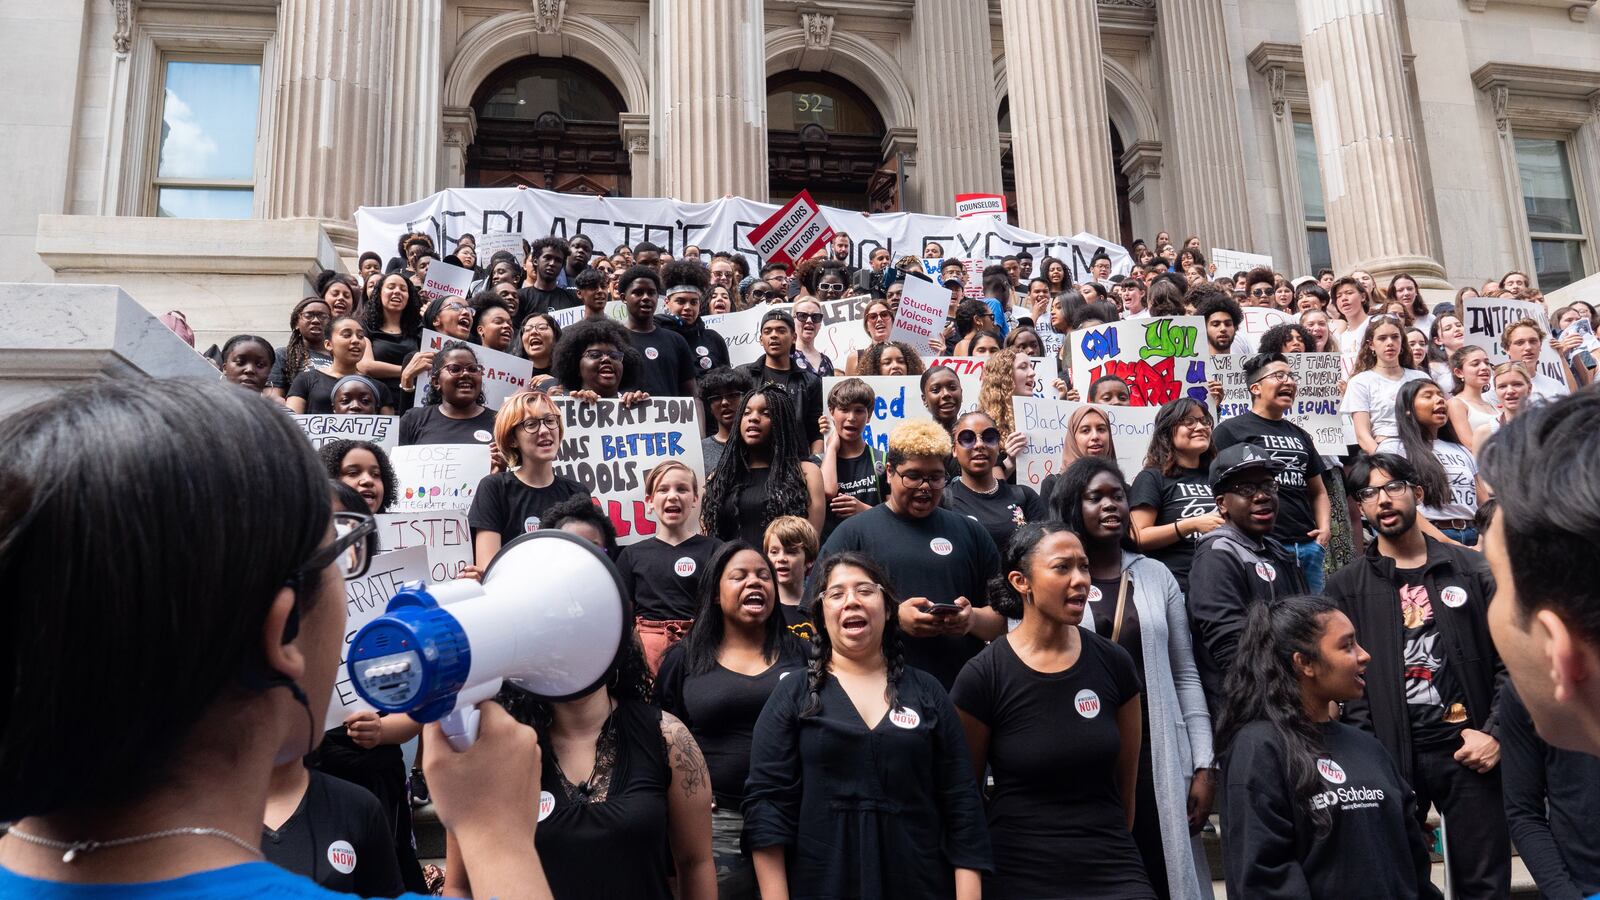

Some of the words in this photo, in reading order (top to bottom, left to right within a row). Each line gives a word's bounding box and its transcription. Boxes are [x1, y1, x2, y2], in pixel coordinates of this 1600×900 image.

[798, 94, 823, 112] 52
[959, 200, 1000, 212] COUNSELORS
[760, 205, 807, 255] COUNSELORS
[788, 239, 804, 257] NOT
[800, 222, 820, 244] COPS
[426, 279, 463, 297] Student
[903, 296, 943, 318] Student
[900, 307, 933, 326] Voices
[896, 319, 932, 337] Matter
[1138, 318, 1200, 360] YOU
[555, 399, 695, 428] EGRATION
[1023, 402, 1068, 431] Black
[555, 435, 590, 462] ANS
[601, 431, 686, 462] BETTER
[1260, 434, 1304, 450] TEENS
[407, 446, 461, 462] LOSE
[417, 463, 461, 480] THE
[1176, 482, 1213, 497] TEEN
[590, 496, 657, 538] LL
[377, 518, 469, 552] ISTEN
[677, 564, 694, 572] NOW
[1078, 700, 1099, 713] NOW
[893, 713, 917, 726] NOW
[1320, 764, 1343, 781] NOW
[1337, 786, 1384, 803] Scholars
[333, 852, 354, 868] NOW
